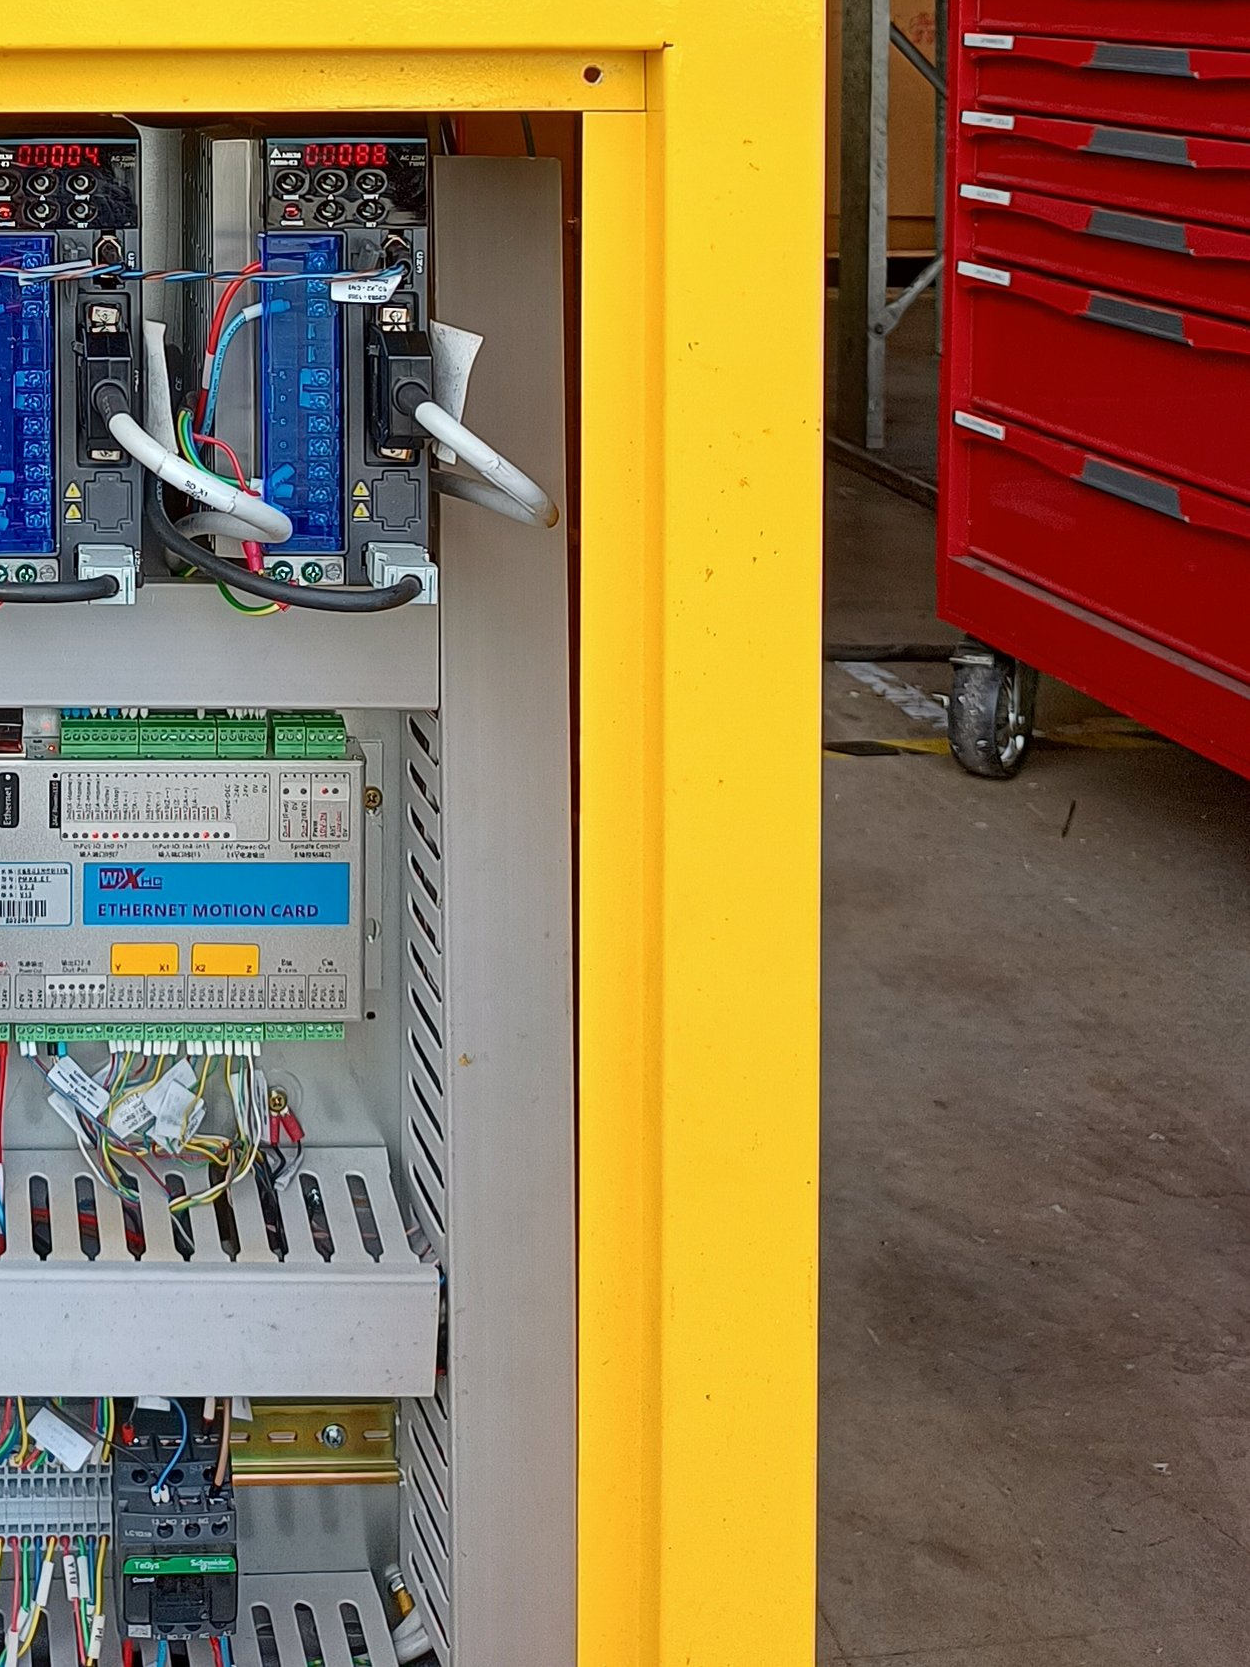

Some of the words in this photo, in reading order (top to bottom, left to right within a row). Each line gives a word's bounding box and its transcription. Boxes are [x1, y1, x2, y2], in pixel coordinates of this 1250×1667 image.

[3, 786, 12, 826] Ethernet
[98, 902, 187, 918] ETHERNET
[193, 903, 268, 918] MOTION
[271, 904, 320, 918] CARD
[195, 964, 206, 972] X2
[246, 965, 252, 973] Z
